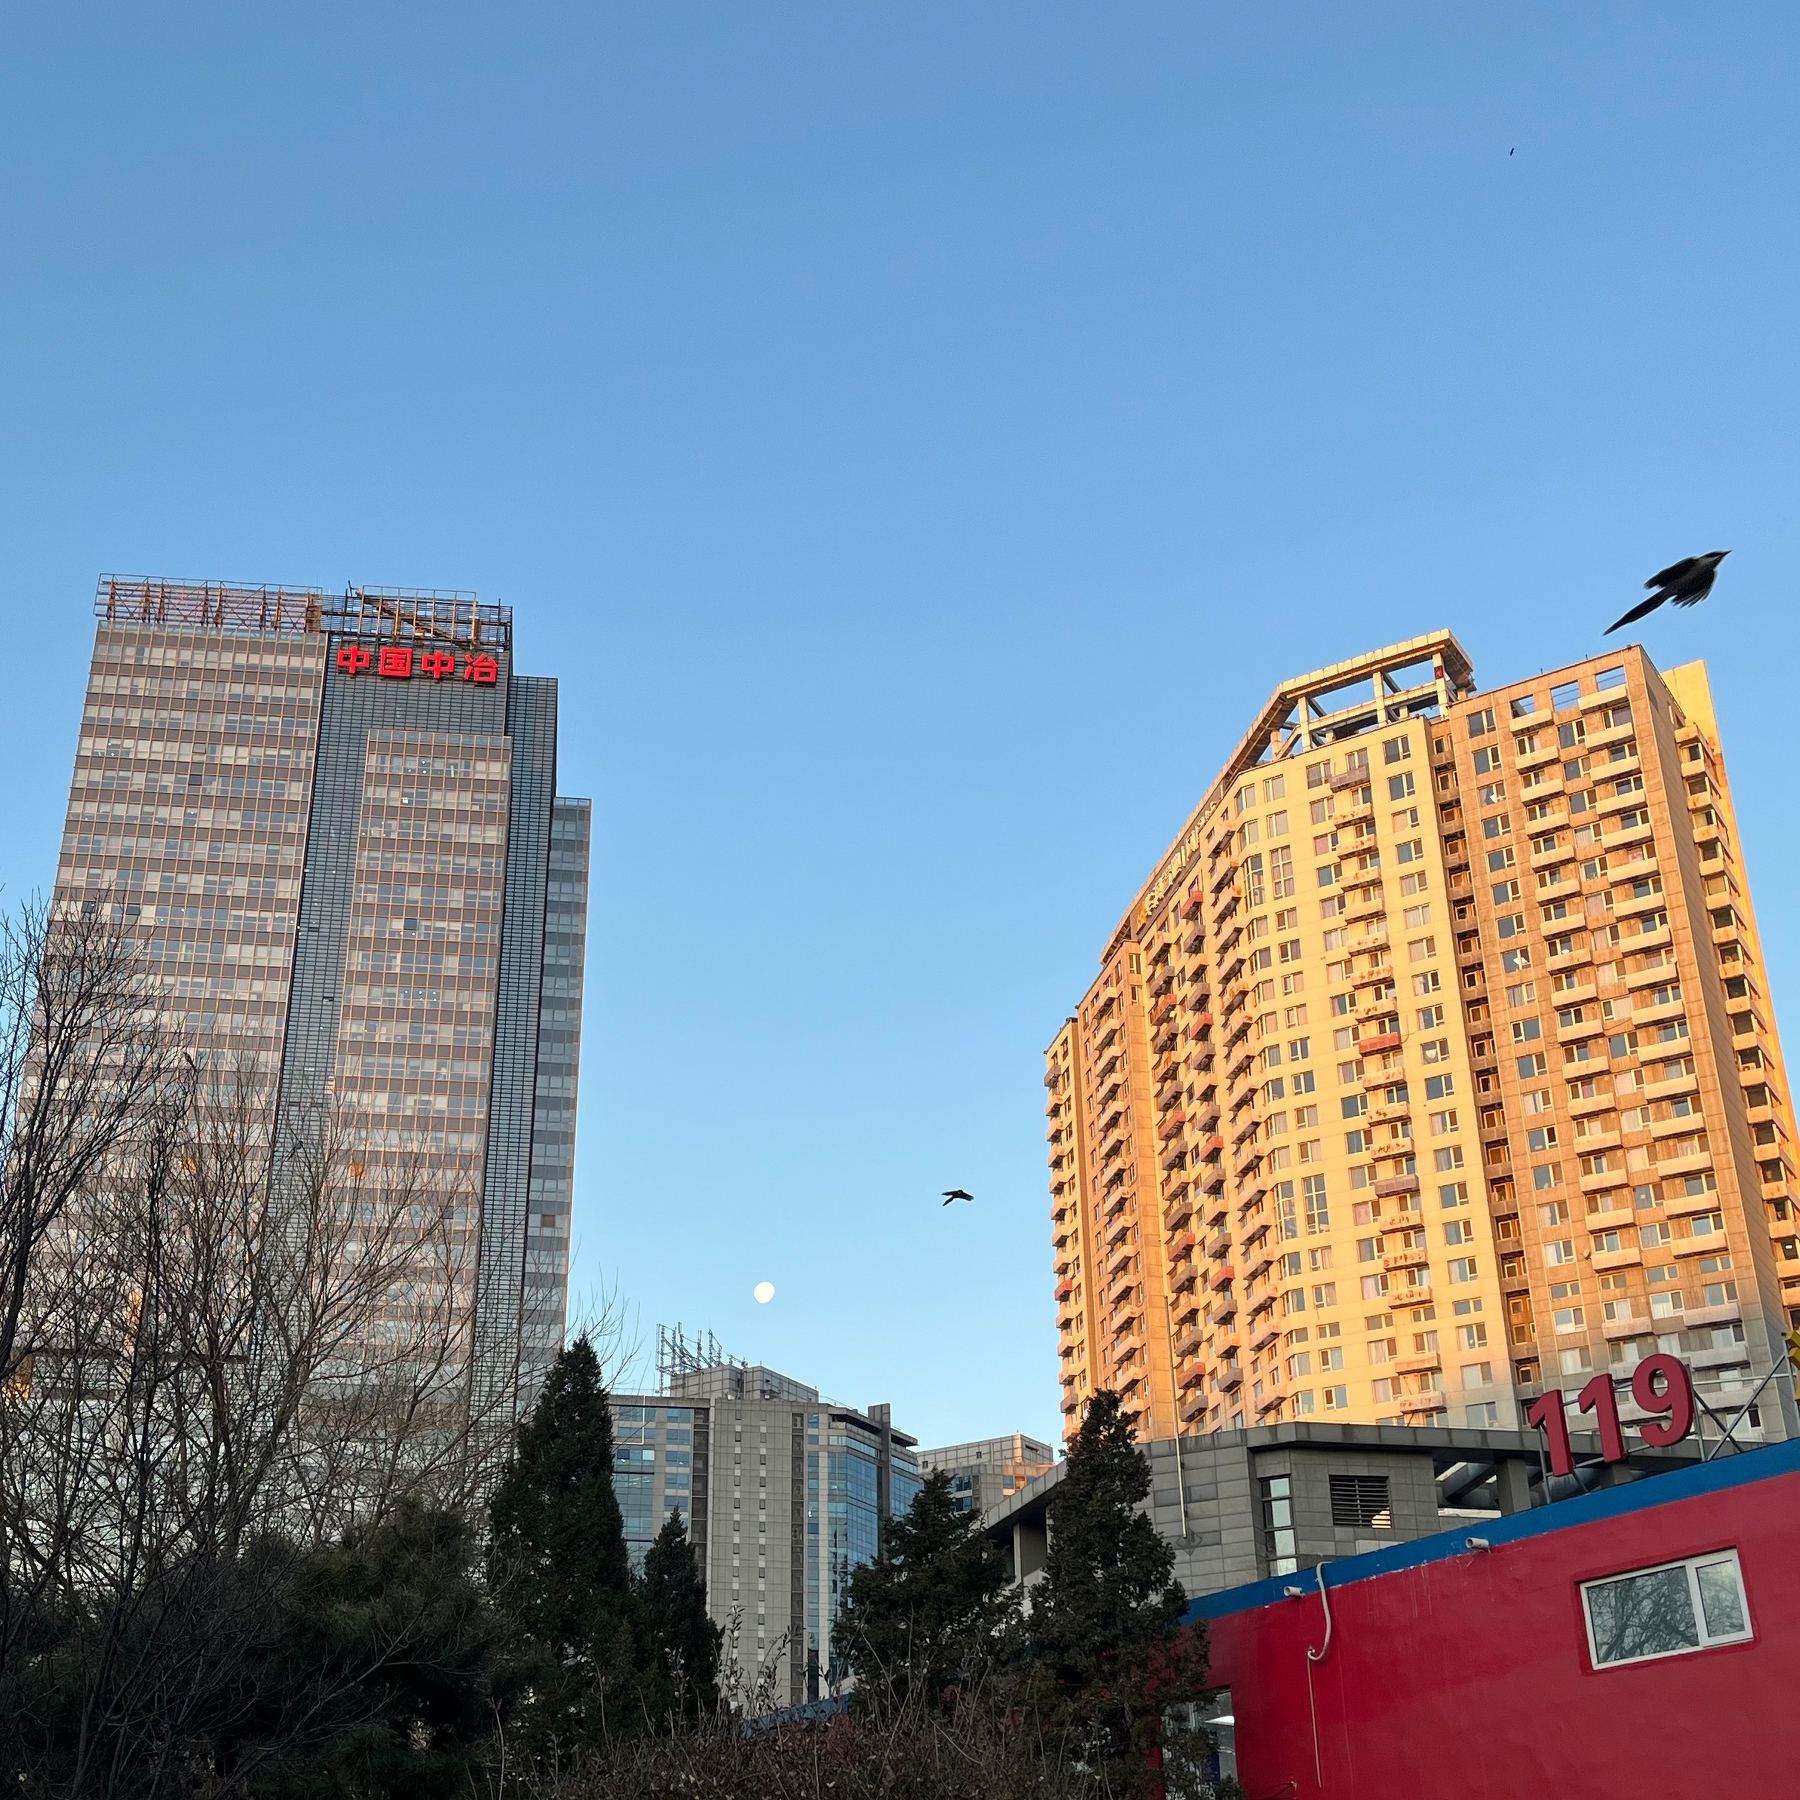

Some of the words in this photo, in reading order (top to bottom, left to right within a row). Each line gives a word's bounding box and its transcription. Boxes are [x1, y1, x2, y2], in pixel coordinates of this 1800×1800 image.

[337, 646, 498, 682] 中国中冶
[1529, 1354, 1695, 1477] 119
